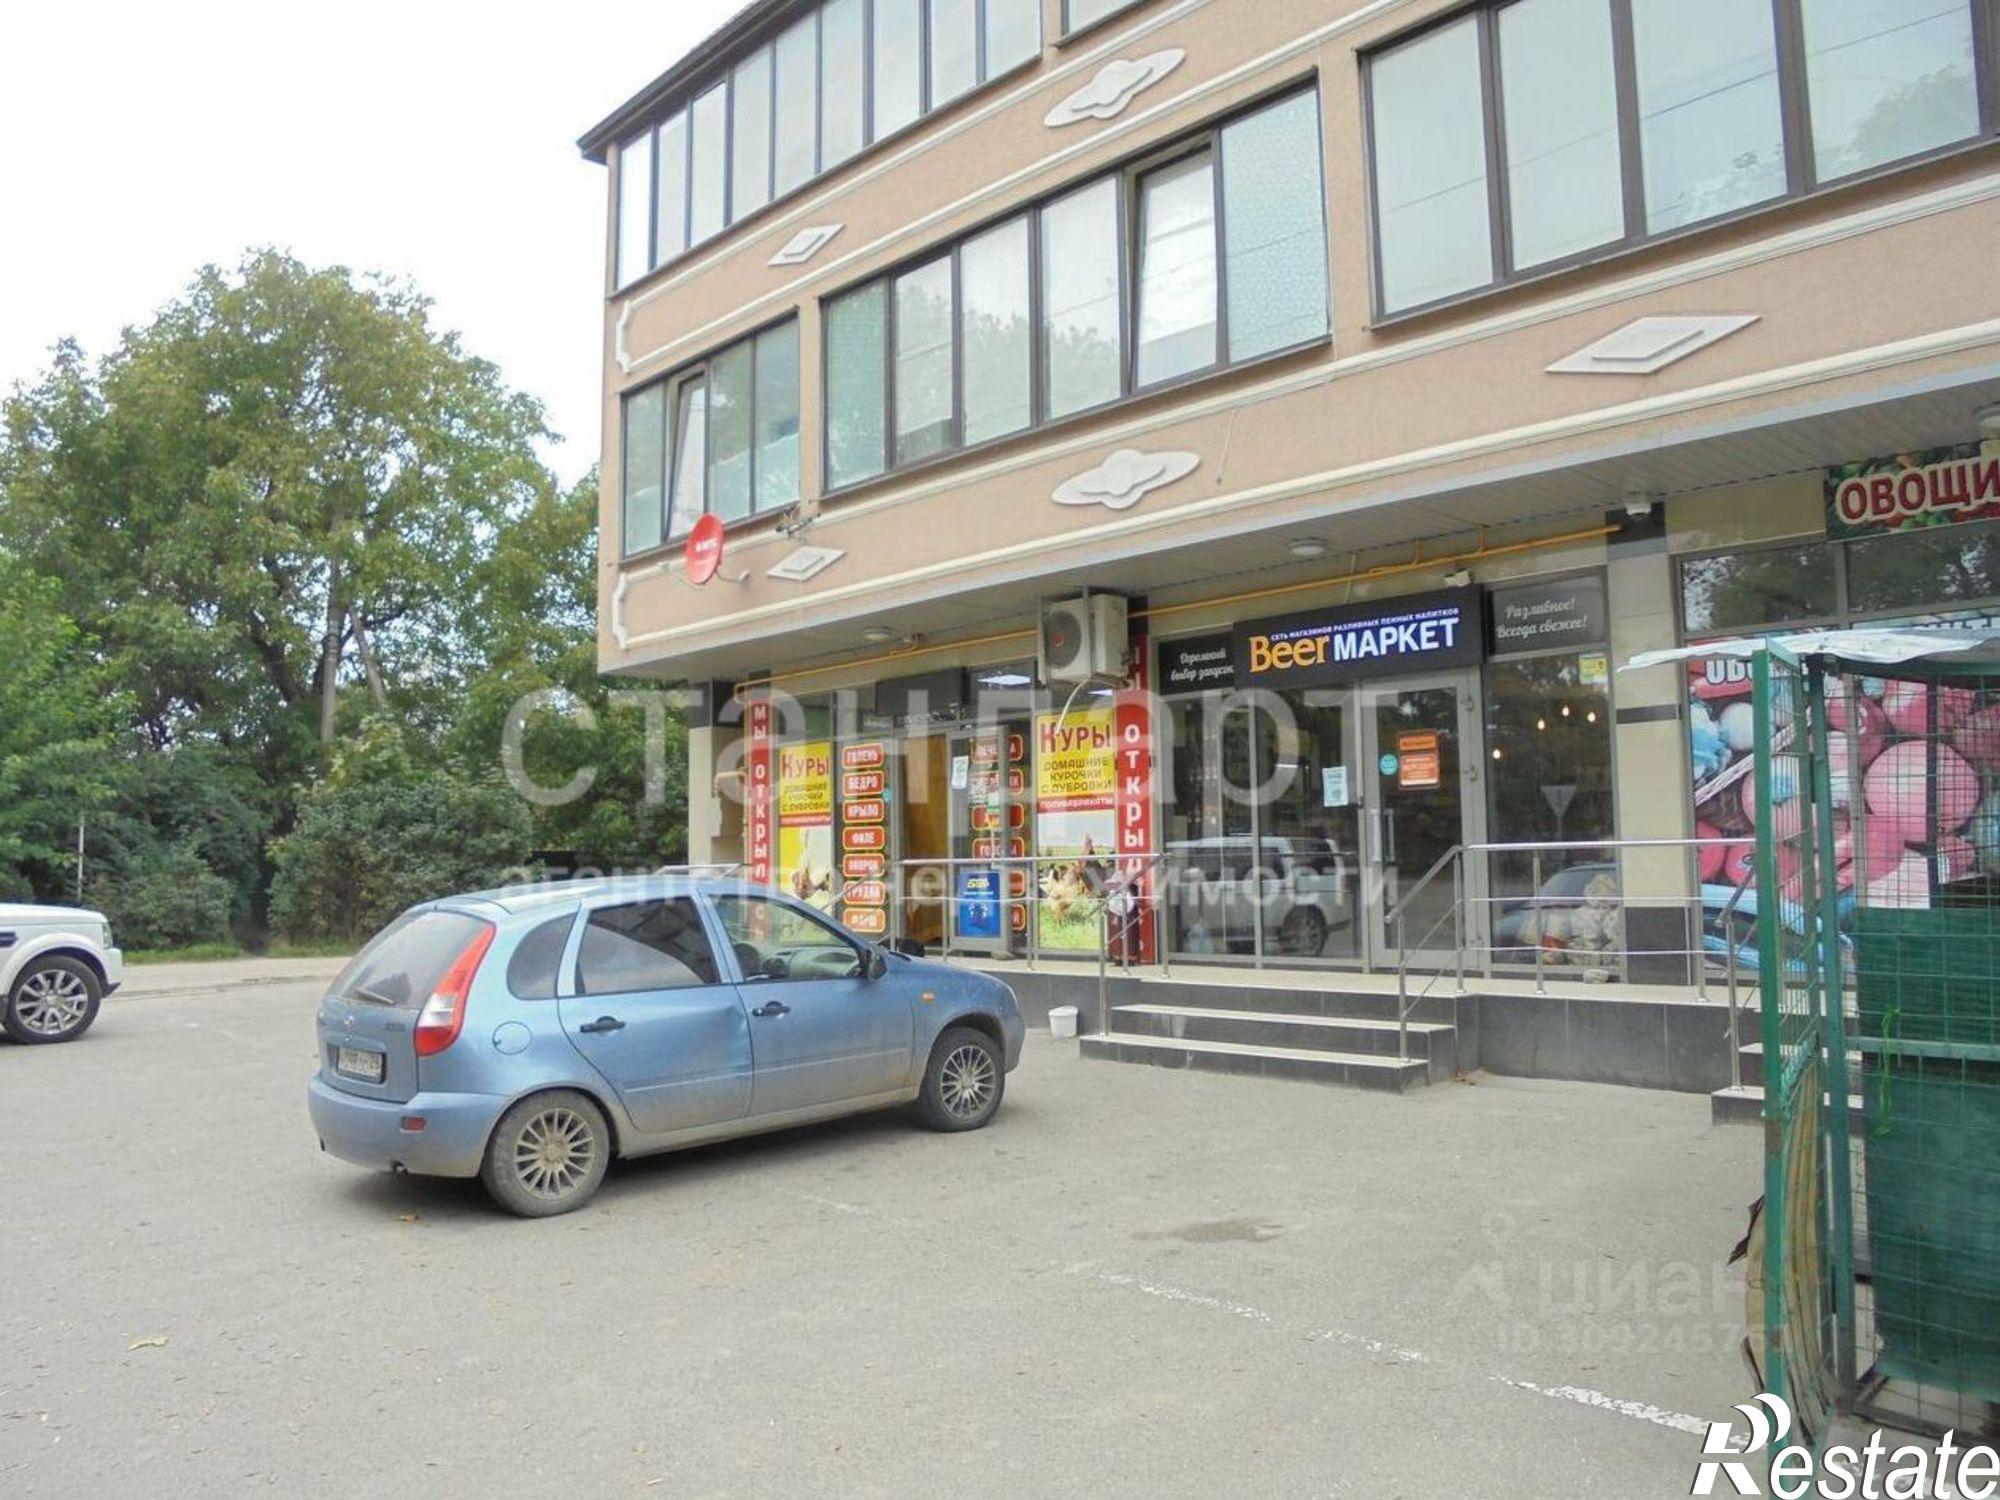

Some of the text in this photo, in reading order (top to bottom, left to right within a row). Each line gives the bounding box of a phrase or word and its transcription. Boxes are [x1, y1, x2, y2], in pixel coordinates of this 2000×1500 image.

[1840, 457, 2000, 520] ОВОЩИ
[1271, 607, 1460, 641] СЕТЬ МАГАЗИНОВ РАЗЛИВНЫХ ПЕННЫХ НАПИТКОВ
[1505, 597, 1576, 620] Разливное!
[1497, 615, 1587, 639] Всегда свежее!
[1248, 617, 1460, 673] Beer МАРКЕТ
